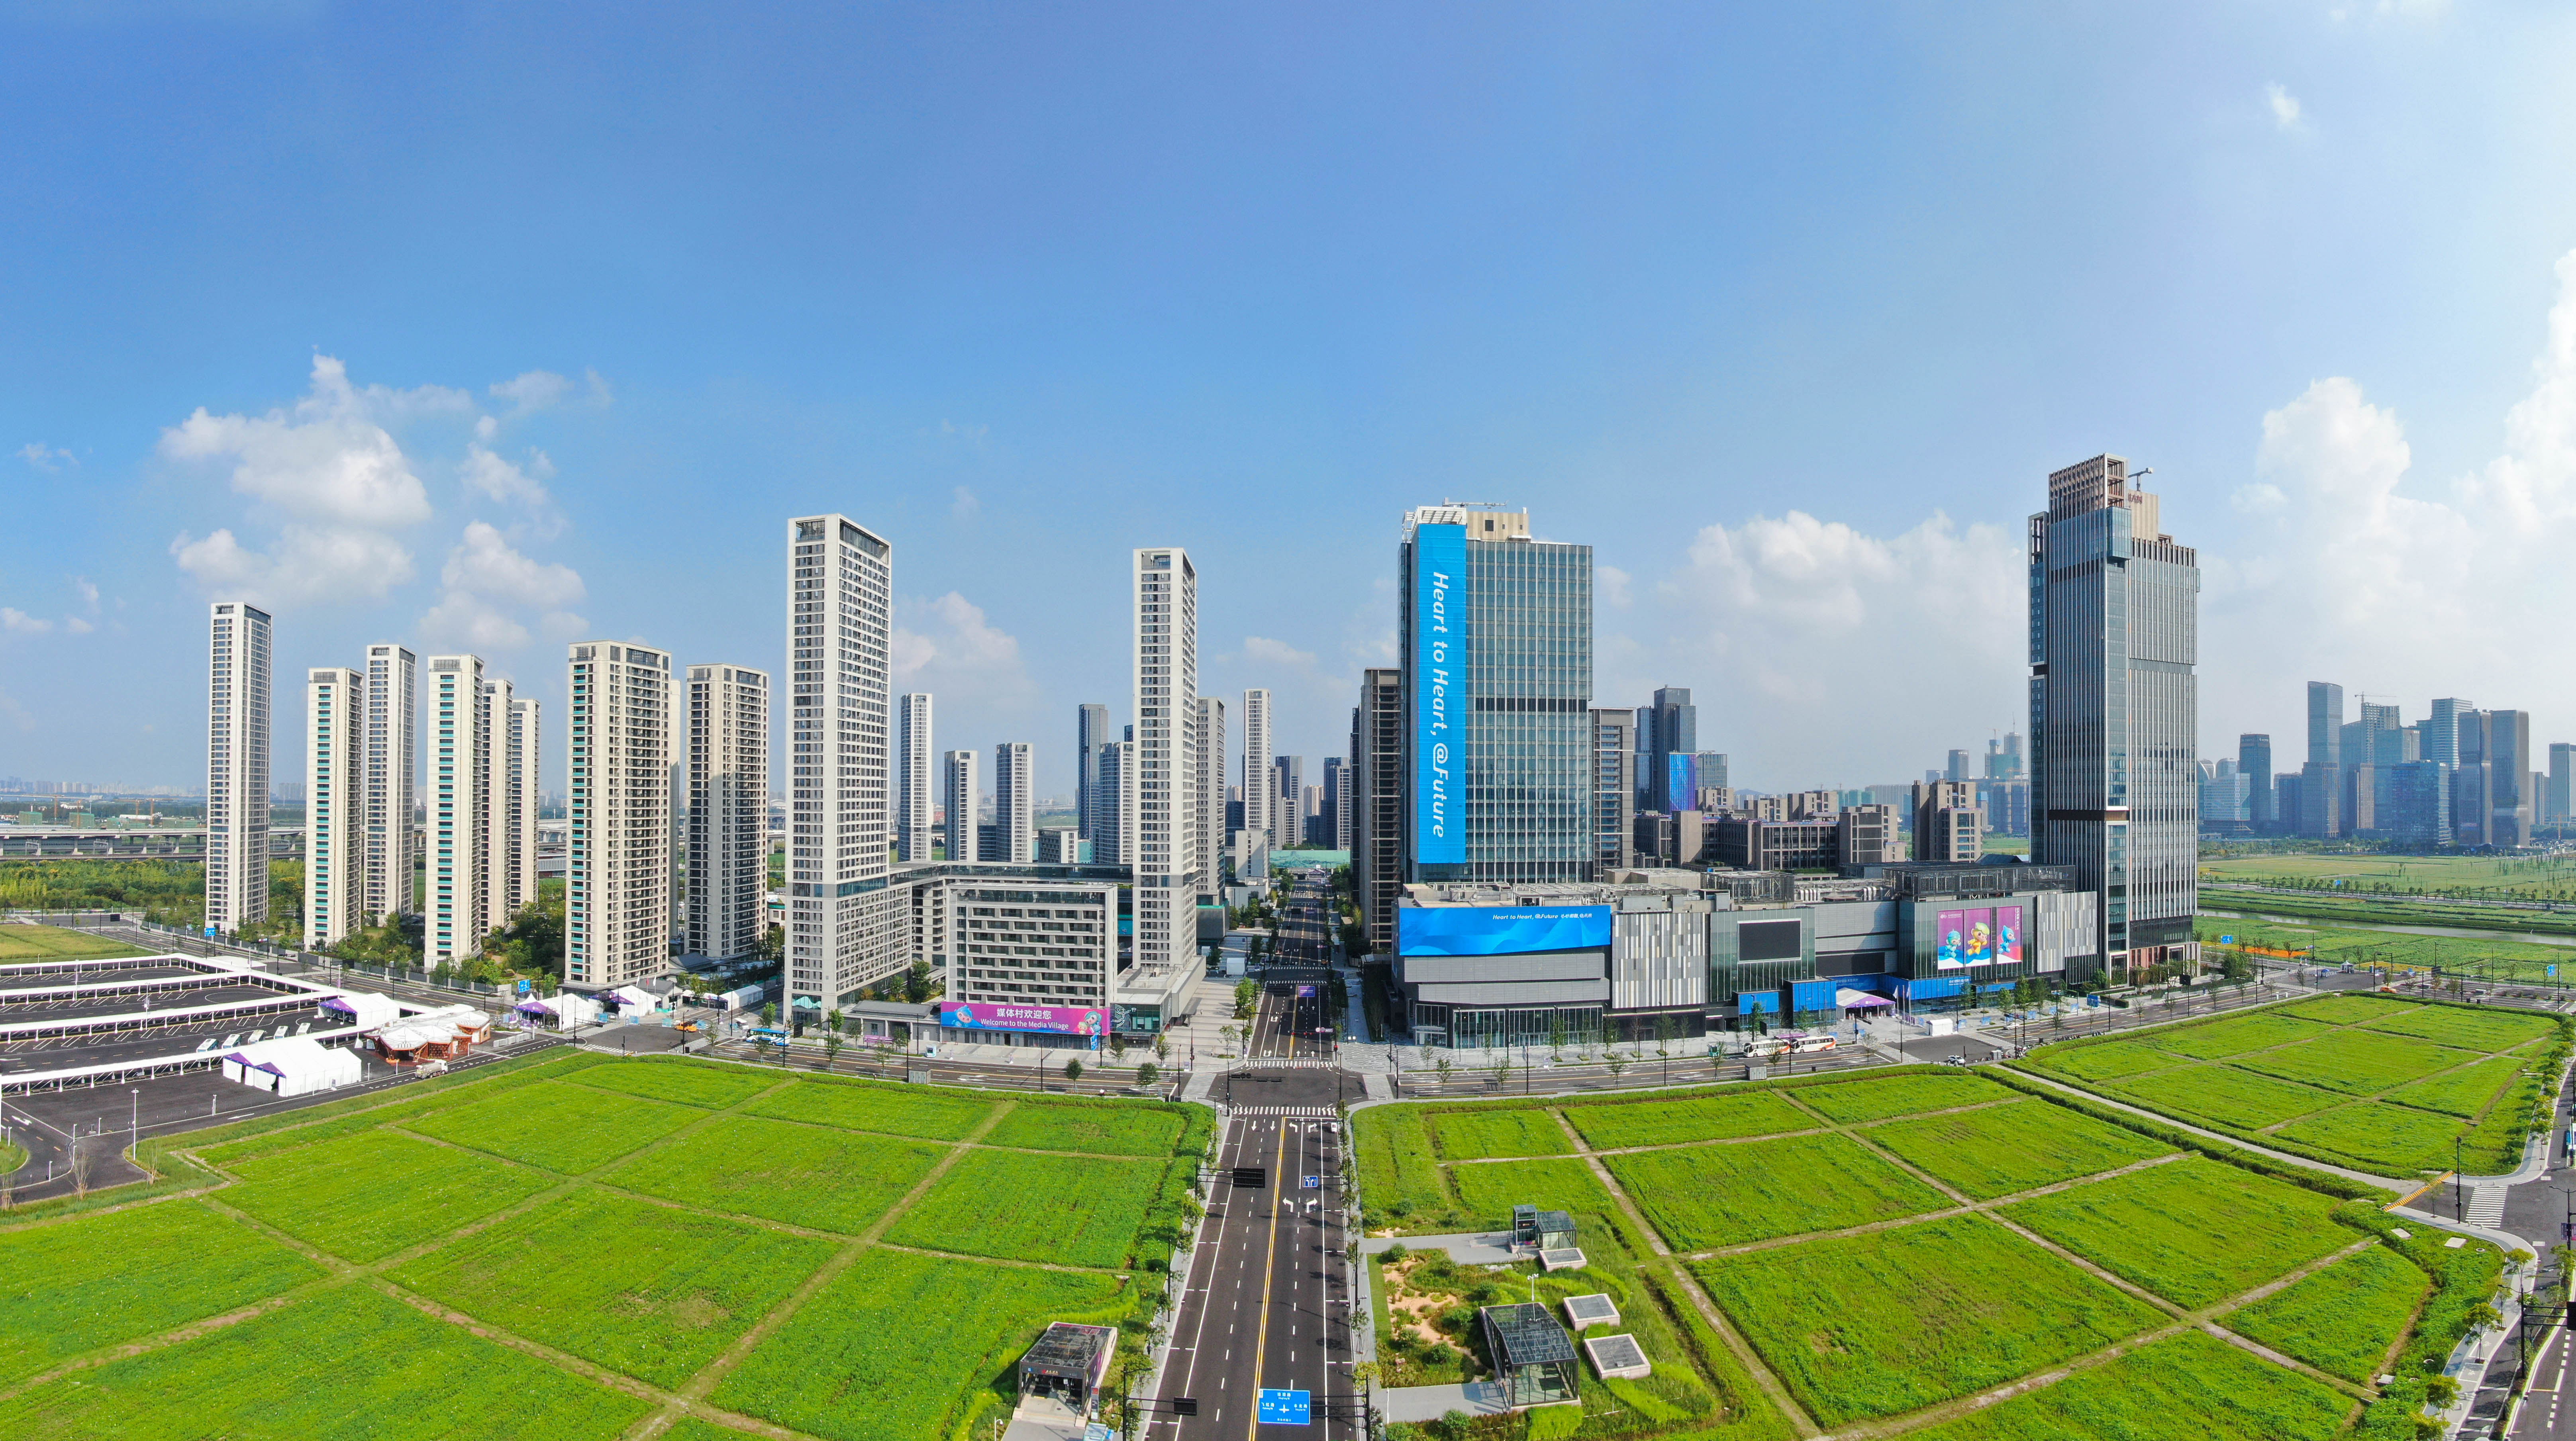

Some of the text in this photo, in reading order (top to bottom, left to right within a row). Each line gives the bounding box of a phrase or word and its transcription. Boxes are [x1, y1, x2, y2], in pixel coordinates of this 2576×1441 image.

[1430, 572, 1449, 837] Heart to Heart, @Future
[997, 1008, 1052, 1019] 媒体村欢迎您
[1048, 1021, 1069, 1031] Village
